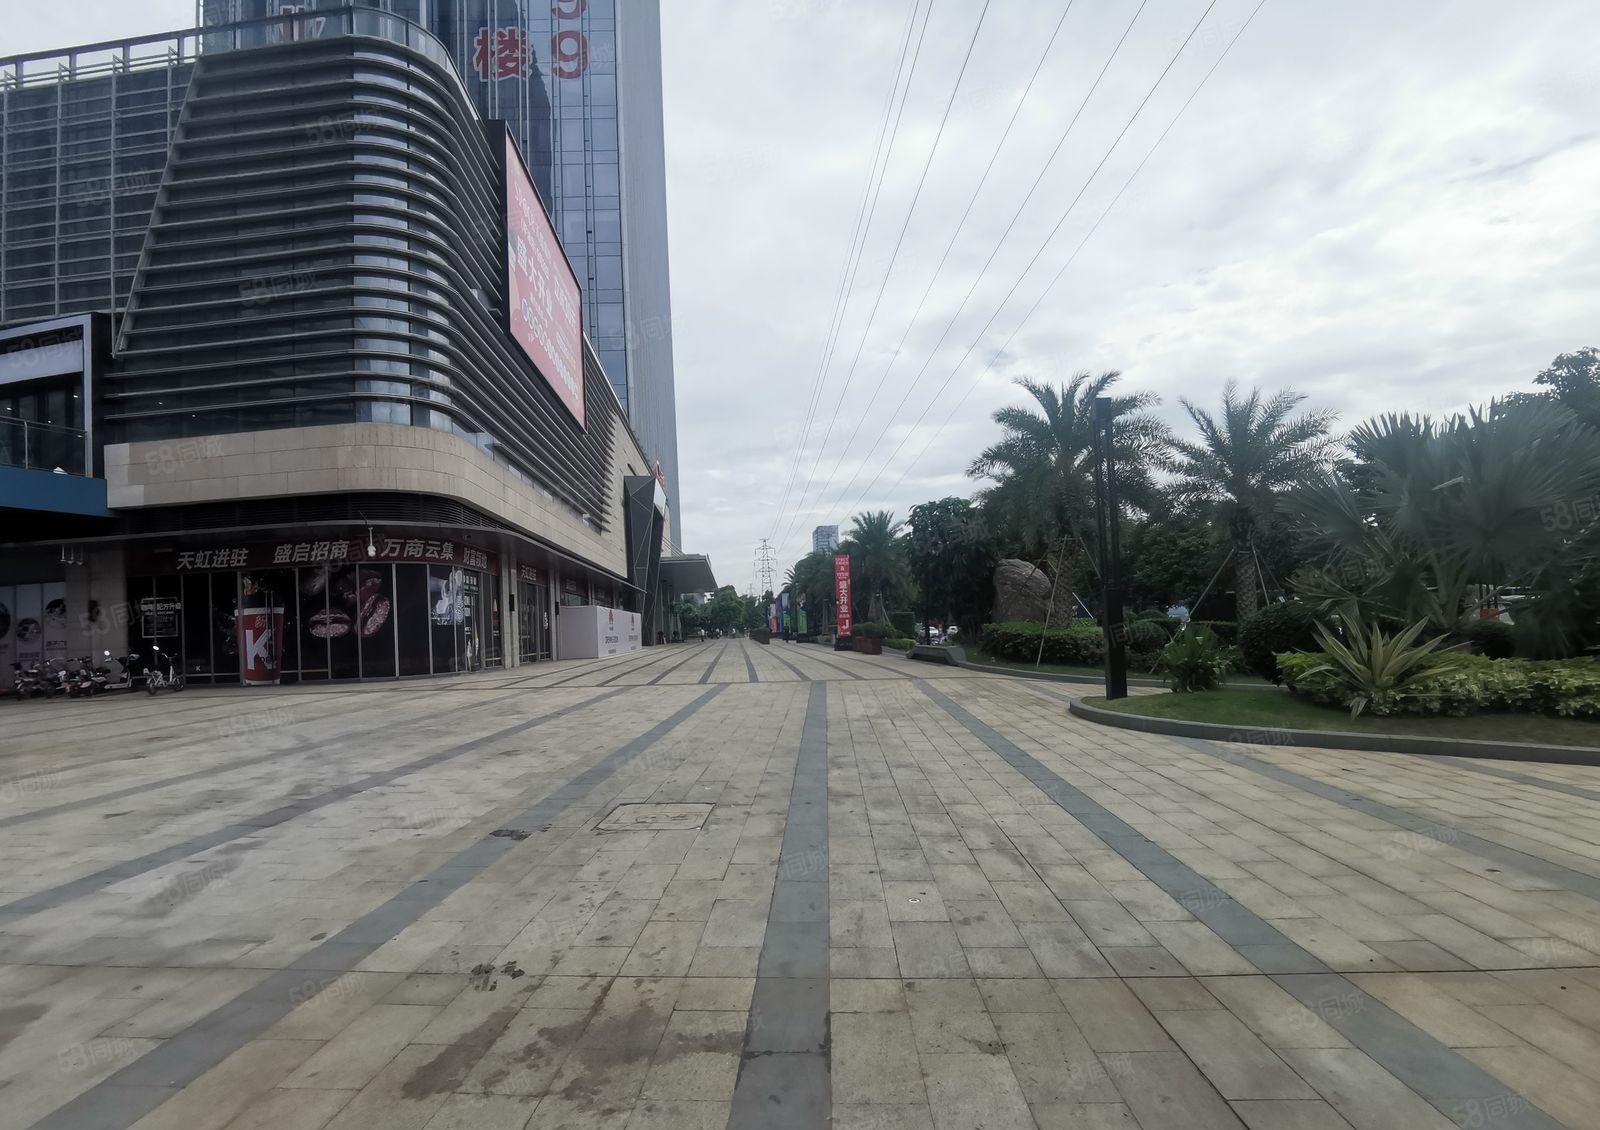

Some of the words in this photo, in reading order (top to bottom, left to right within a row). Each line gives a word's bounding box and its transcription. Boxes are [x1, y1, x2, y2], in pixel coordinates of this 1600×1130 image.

[474, 26, 533, 82] 楼
[175, 547, 249, 570] 天虹进驻
[272, 540, 350, 565] 盛启招商
[380, 538, 454, 561] 万商云集
